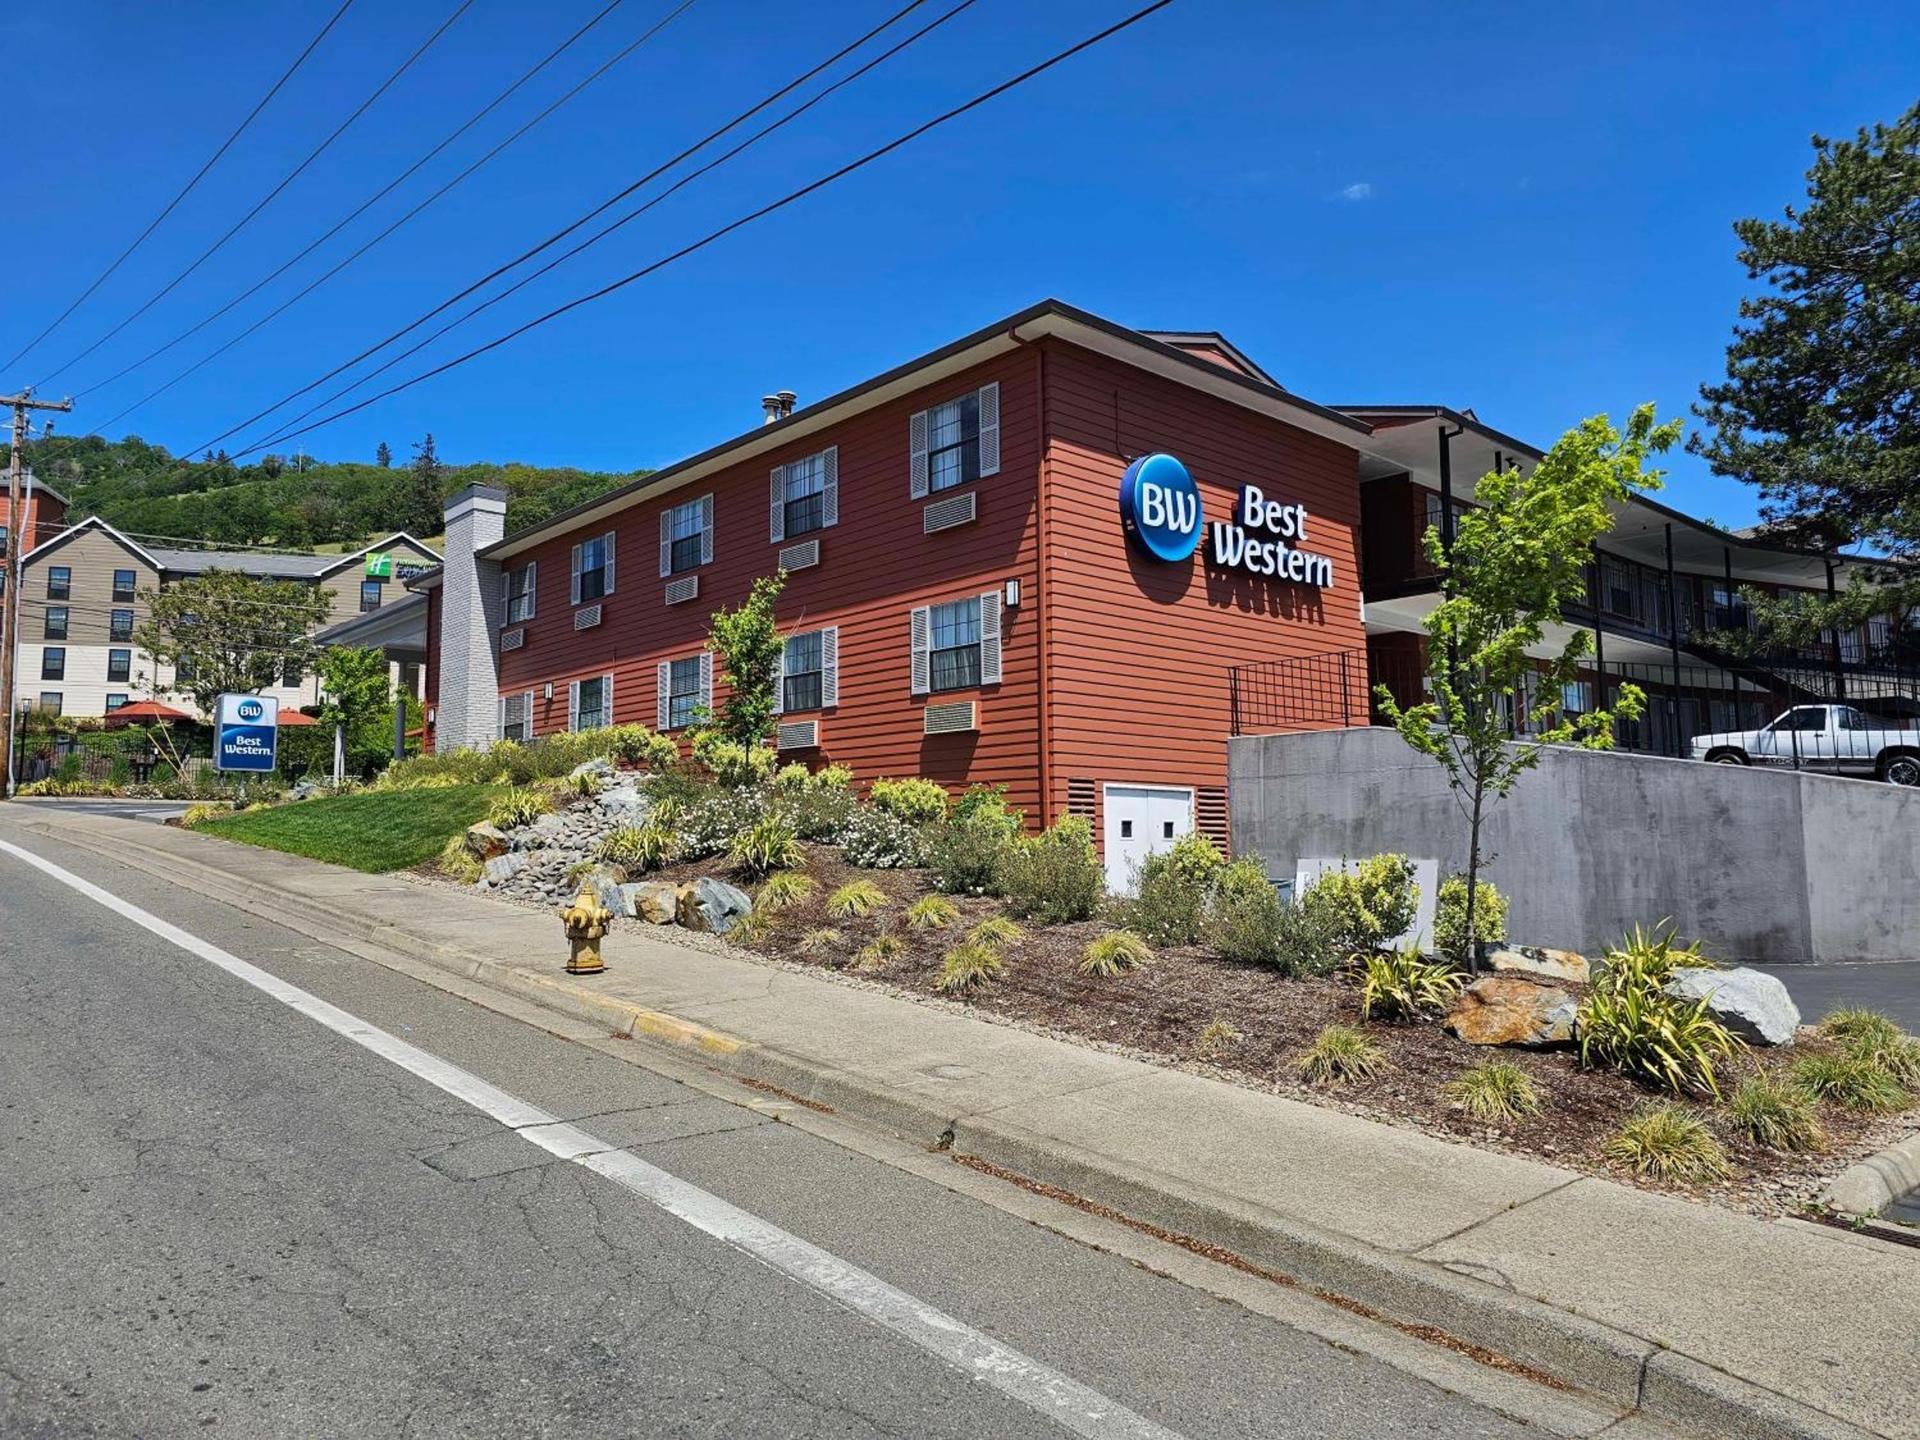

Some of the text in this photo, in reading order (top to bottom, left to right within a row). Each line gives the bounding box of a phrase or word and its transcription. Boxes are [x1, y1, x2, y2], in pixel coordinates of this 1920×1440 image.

[1142, 482, 1196, 534] BW
[1243, 484, 1308, 541] Best
[1213, 521, 1333, 588] Western
[240, 705, 260, 717] BW
[224, 744, 271, 755] Western
[236, 735, 261, 746] Best
